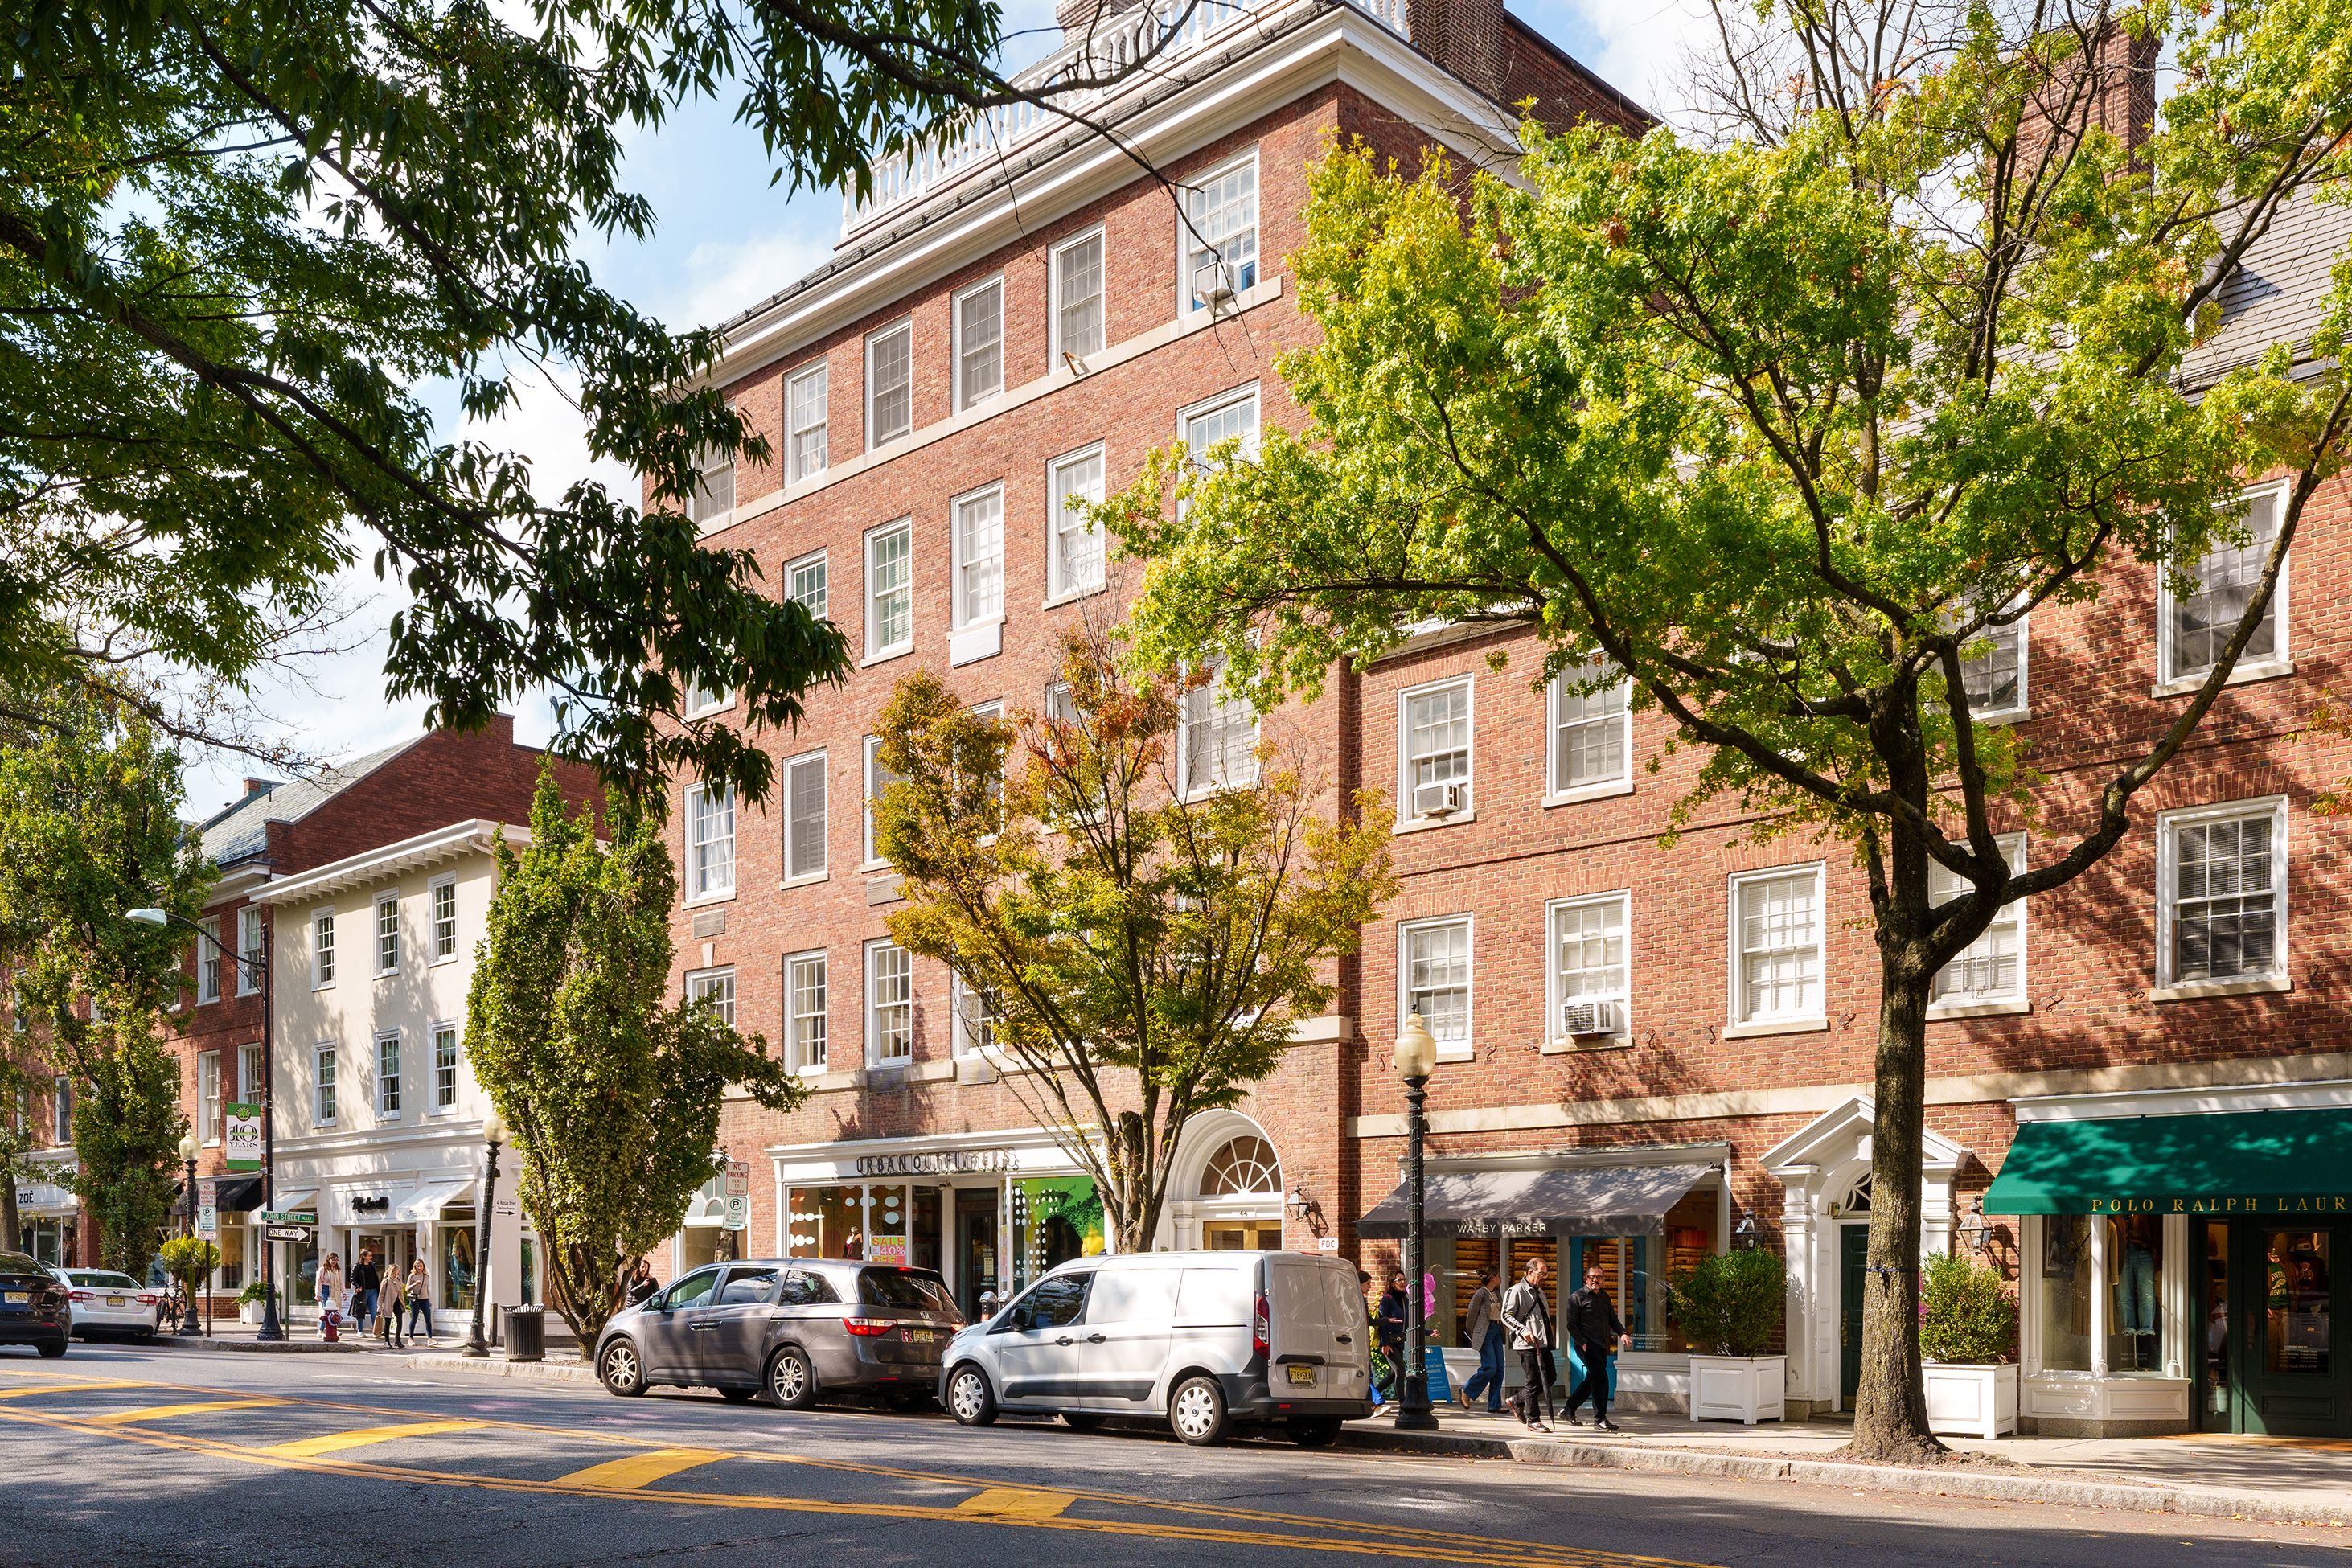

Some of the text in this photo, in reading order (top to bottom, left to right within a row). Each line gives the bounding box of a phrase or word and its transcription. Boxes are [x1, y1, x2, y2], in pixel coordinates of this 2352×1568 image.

[229, 1124, 258, 1142] 10
[856, 1147, 1020, 1175] URBAN OUTFITTERS
[2091, 1197, 2346, 1212] POLO RALPH LAUR
[1457, 1223, 1546, 1233] WARBY PARKER
[872, 1237, 905, 1246] SALE
[1321, 1240, 1335, 1248] FDC
[880, 1247, 905, 1255] 40%
[901, 1328, 913, 1343] R
